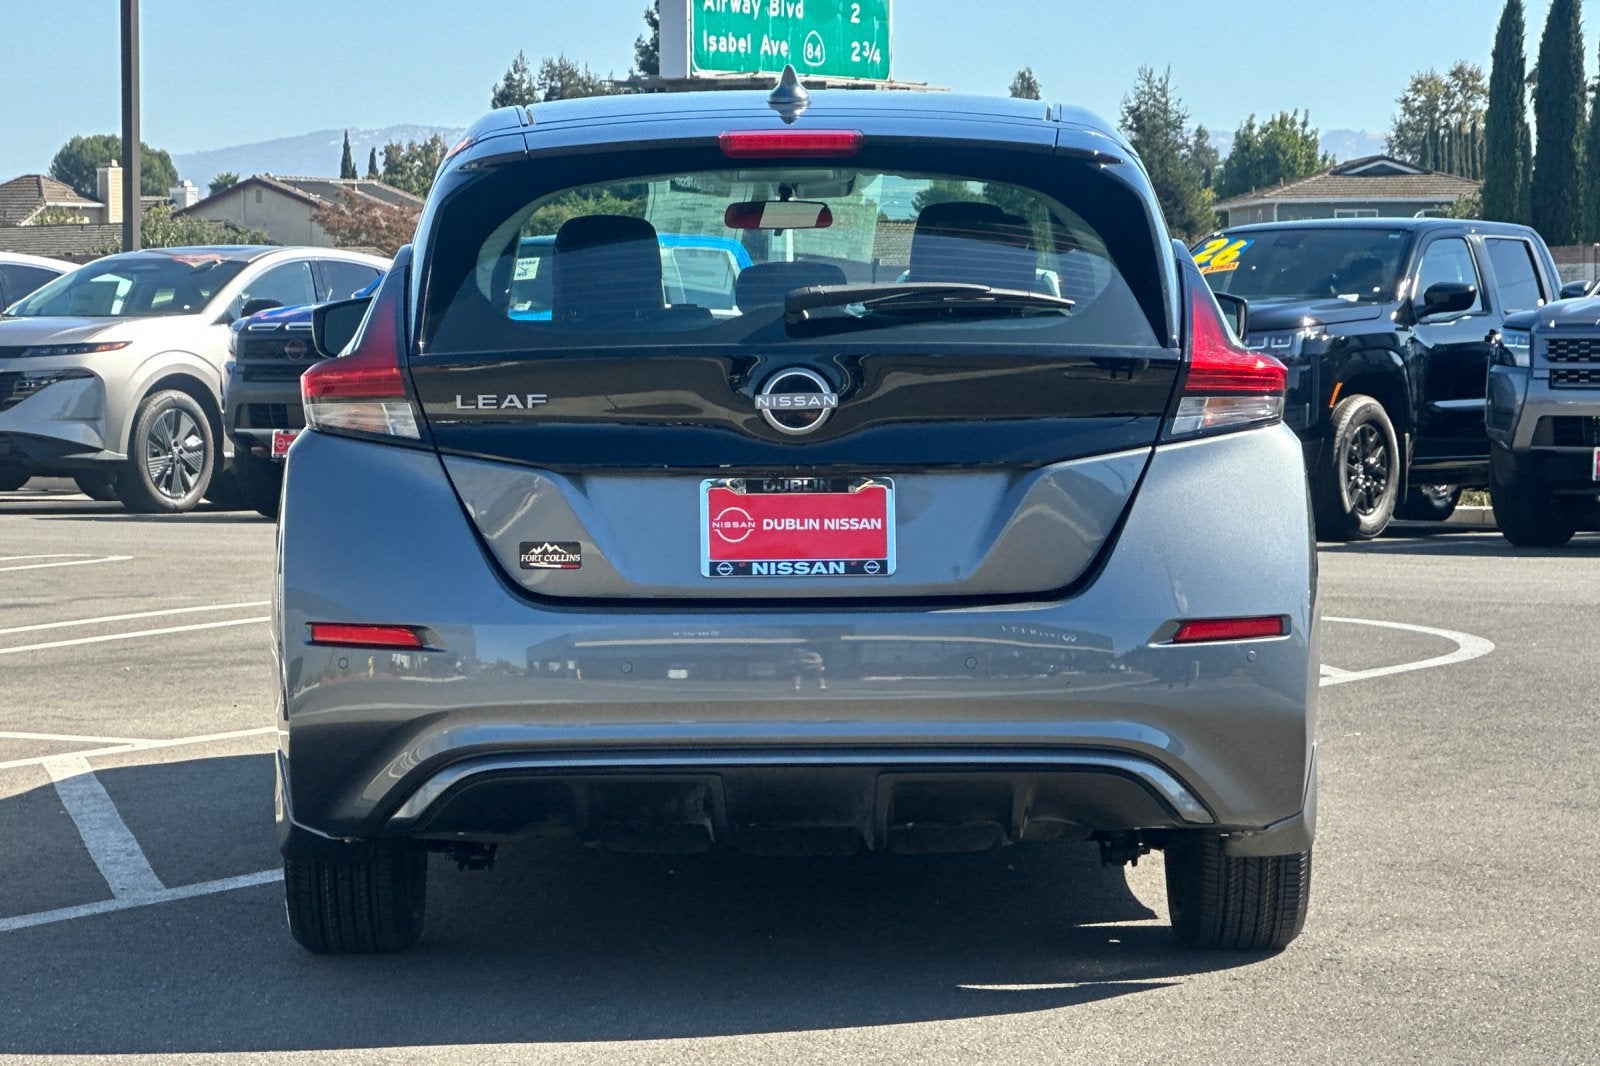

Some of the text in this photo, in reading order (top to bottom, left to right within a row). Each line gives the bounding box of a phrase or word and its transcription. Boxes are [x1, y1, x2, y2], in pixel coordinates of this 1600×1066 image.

[769, 0, 804, 19] Blvd
[850, 3, 861, 24] 2
[703, 29, 752, 54] Isabel
[760, 34, 788, 57] Ave
[807, 42, 821, 60] 84
[1192, 238, 1247, 266] 26
[455, 394, 548, 409] LEAF
[756, 396, 836, 407] NISSAN
[712, 521, 756, 529] NISSAN
[762, 518, 882, 531] DUBLIN NISSAN
[521, 554, 580, 562] FORT COLLINS
[752, 561, 845, 575] NISSAN
